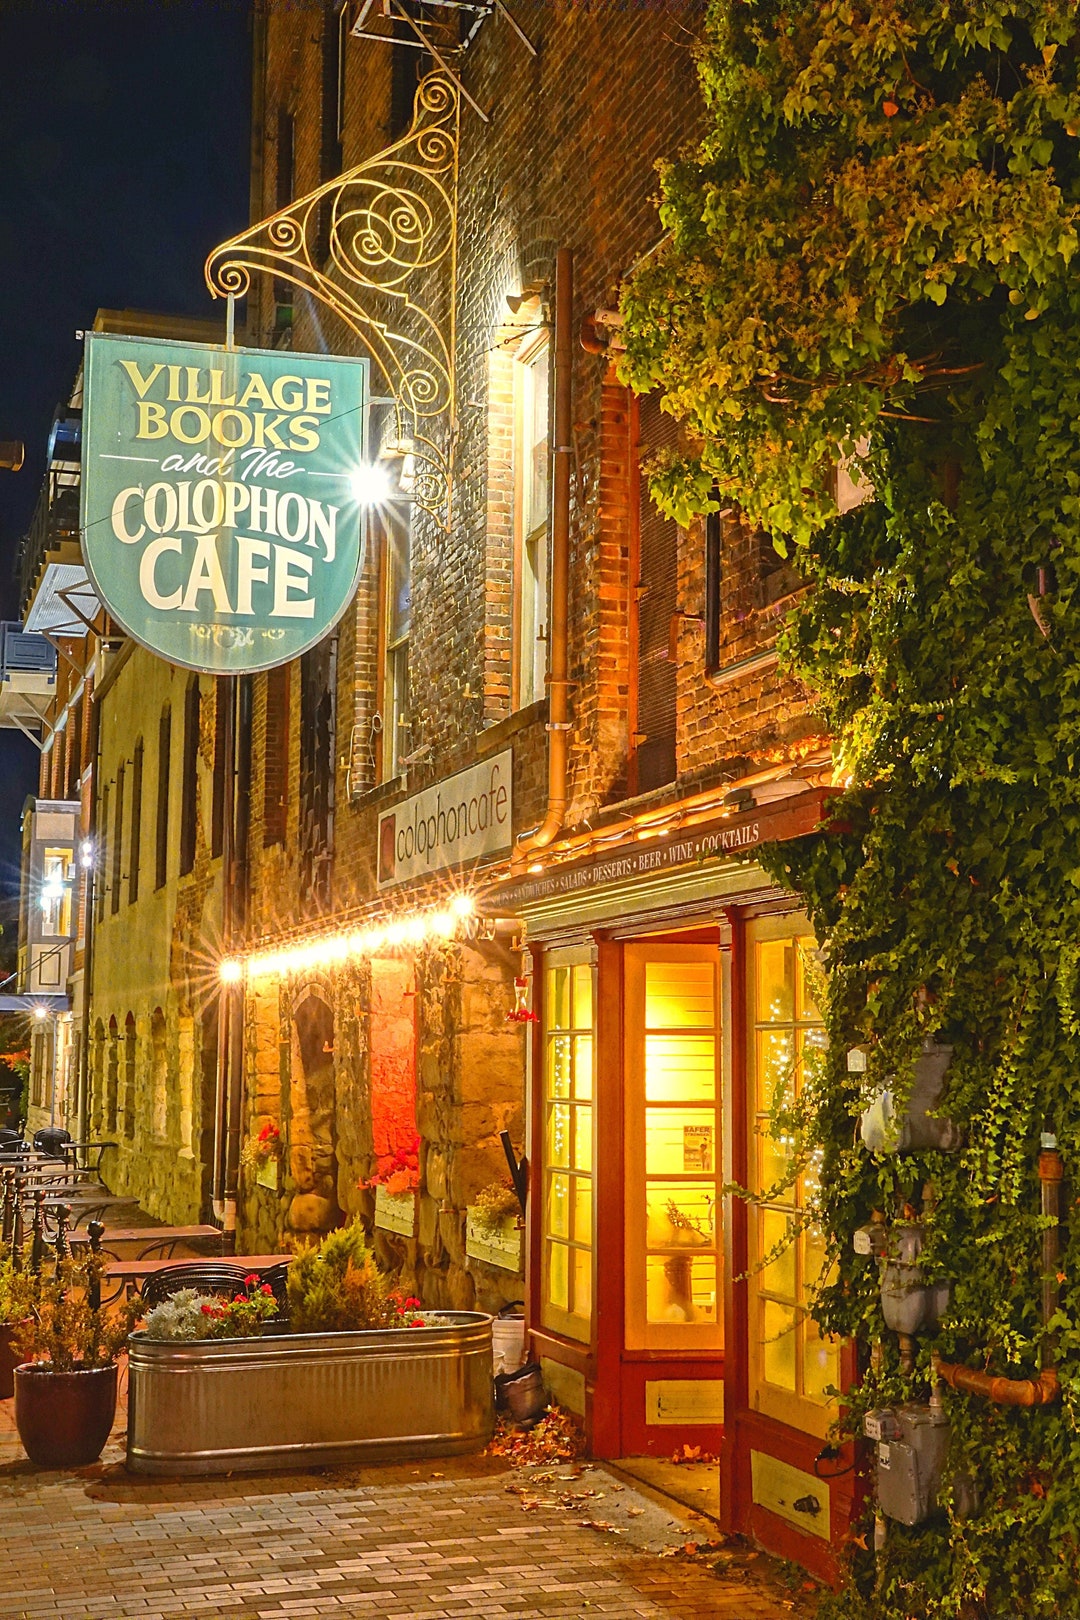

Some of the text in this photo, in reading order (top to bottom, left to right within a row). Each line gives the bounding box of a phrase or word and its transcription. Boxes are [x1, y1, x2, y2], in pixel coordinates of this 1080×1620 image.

[118, 359, 332, 415] VILLAGE
[135, 401, 321, 453] BOOKS
[160, 447, 306, 481] and The
[111, 479, 341, 562] COLOPHON
[138, 533, 317, 620] CAFE
[560, 870, 587, 892] SALADS
[592, 857, 632, 883] DESSERTS
[638, 852, 662, 871] BEER
[668, 841, 694, 864] WINE
[701, 823, 760, 853] COCKTAILS
